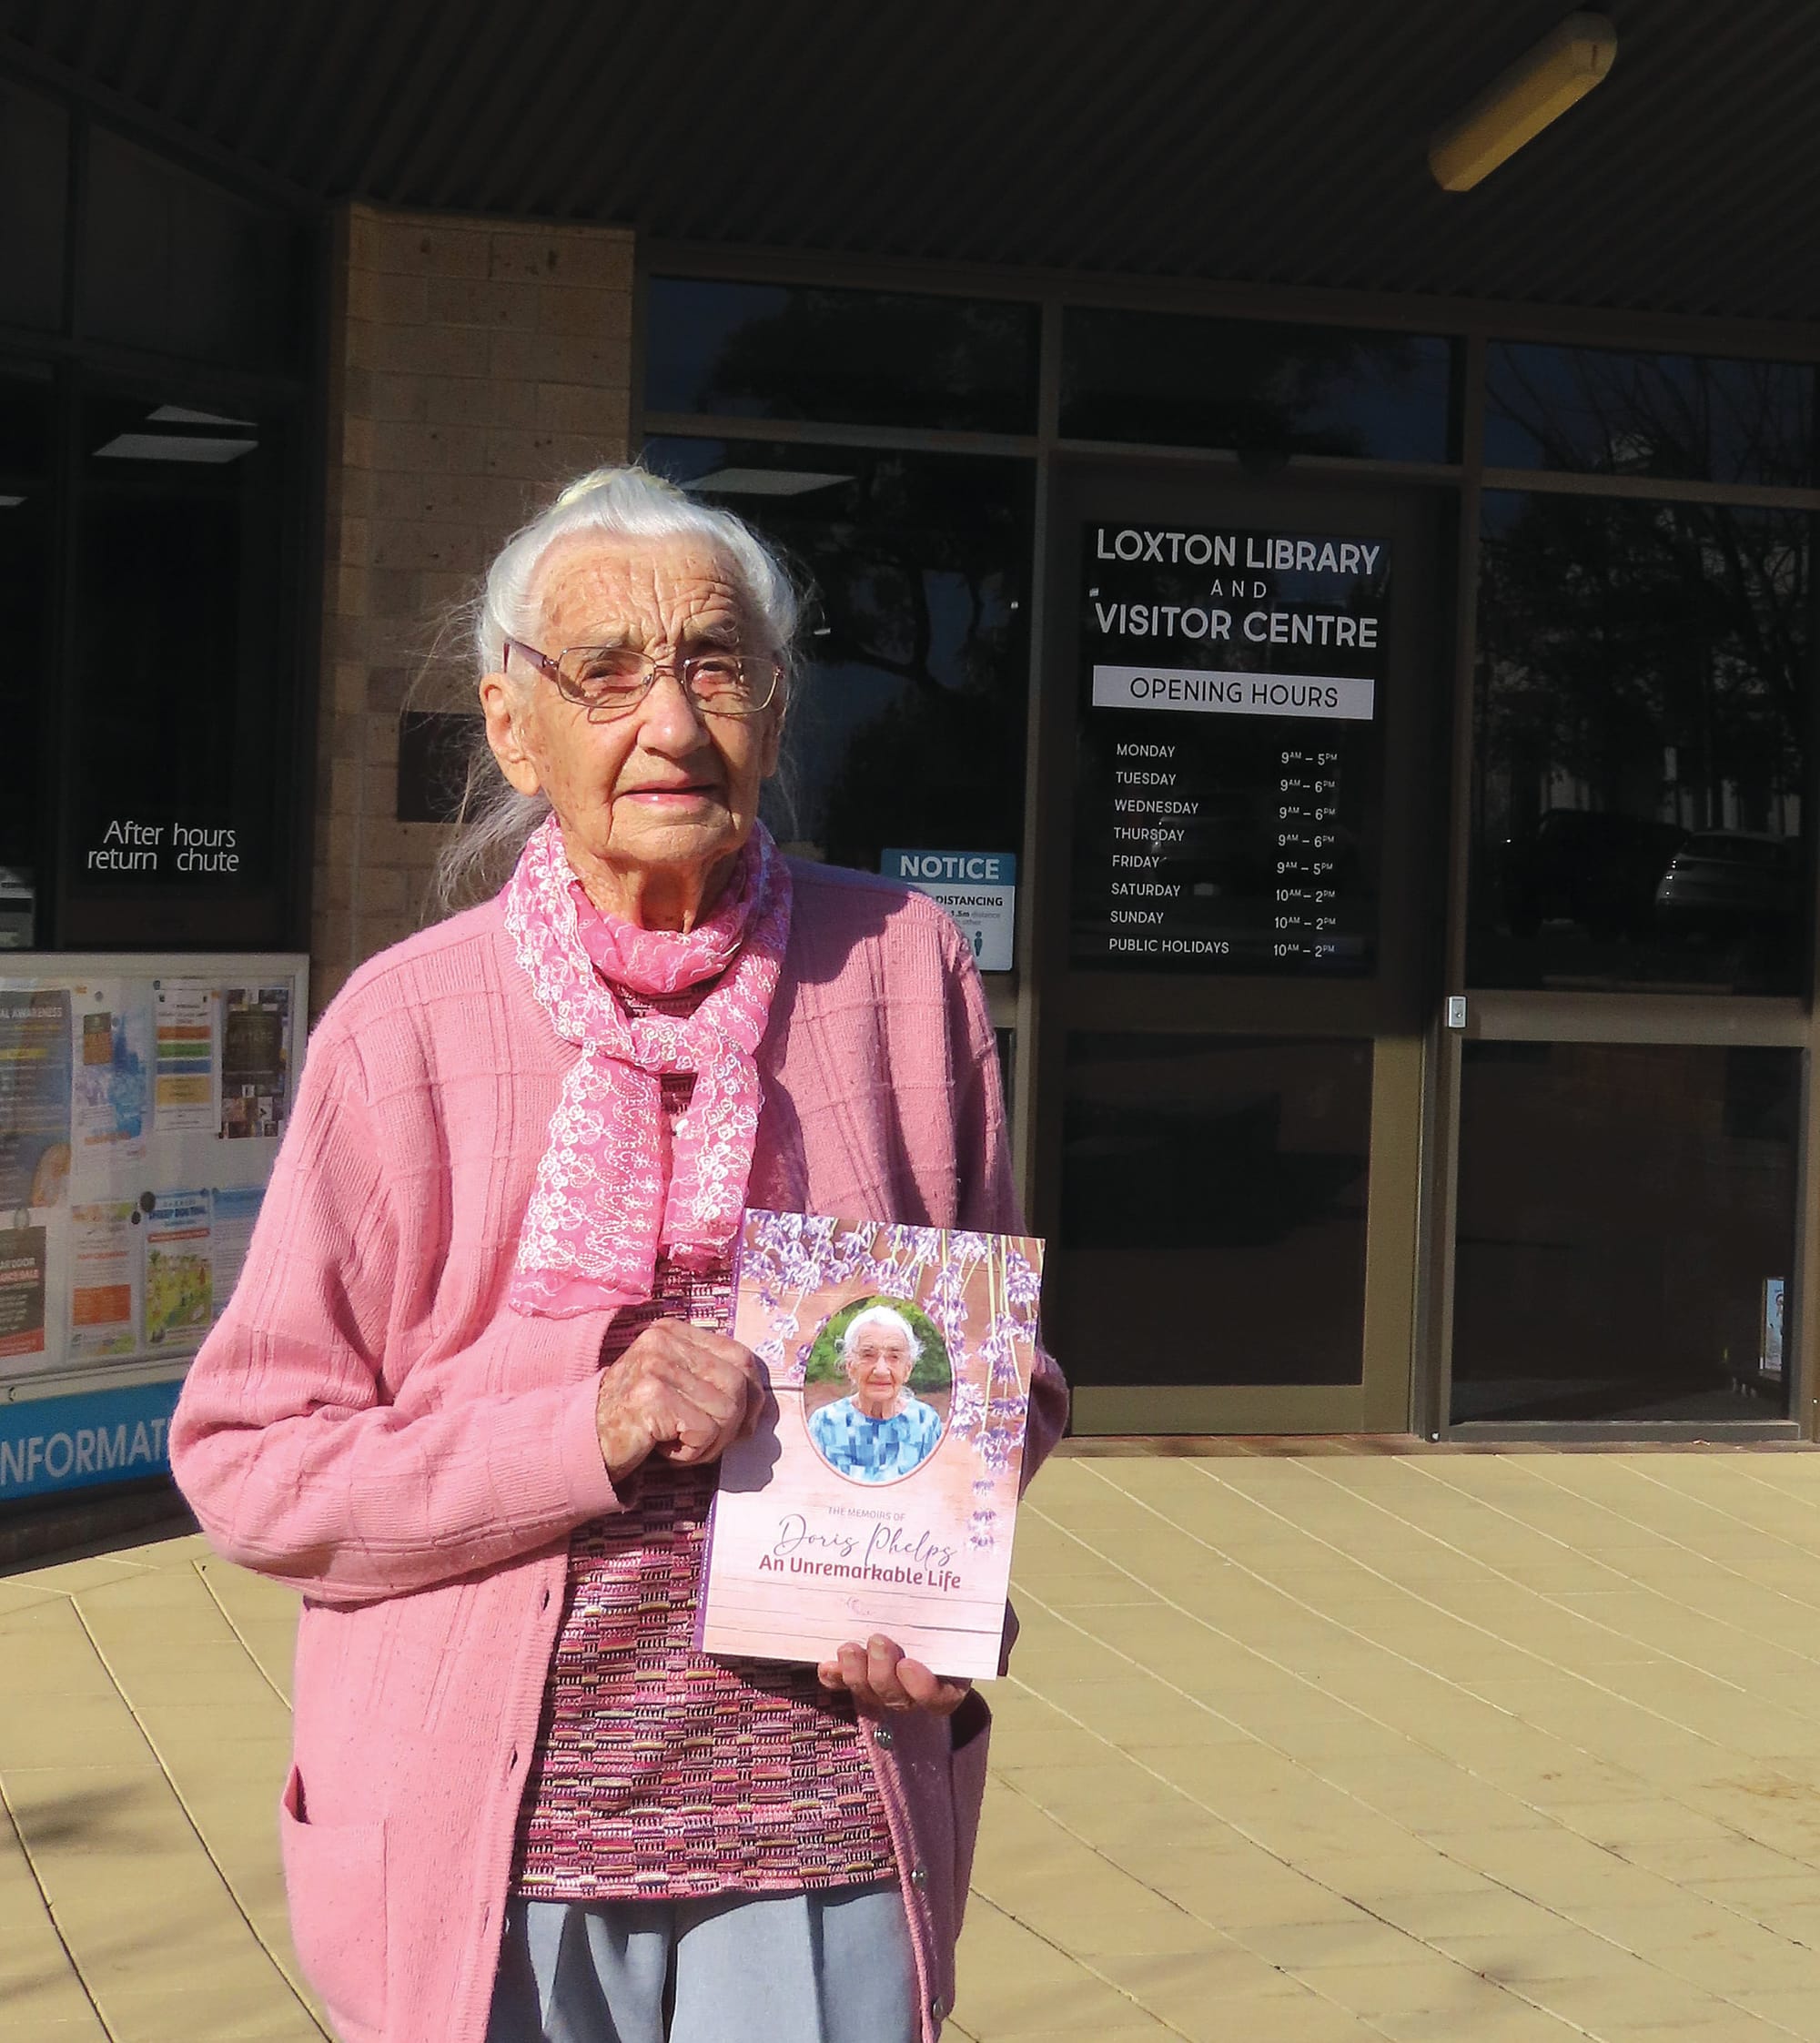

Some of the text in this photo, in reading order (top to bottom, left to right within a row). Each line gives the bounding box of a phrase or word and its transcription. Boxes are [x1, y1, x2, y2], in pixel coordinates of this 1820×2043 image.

[1097, 528, 1380, 575] LOXTON LIBRARY
[1210, 579, 1267, 599] AND
[1095, 602, 1378, 648] VISITOR CENTRE
[1129, 677, 1338, 708] OPENING HOURS
[1117, 743, 1176, 758] MONDAY
[1281, 751, 1302, 764] 9AM
[1317, 753, 1338, 766] 5PM
[1116, 771, 1177, 786] TUESDAY
[1280, 779, 1301, 792] 9AM
[1314, 780, 1335, 794] 6PM
[1114, 799, 1198, 814] WEDNESDAY
[1279, 805, 1300, 819] 9AM
[1315, 807, 1336, 821] 6PM
[103, 820, 236, 848] After hours
[1113, 827, 1185, 841] THURSDAY
[1278, 834, 1299, 846] 9AM
[1314, 834, 1335, 848] 6PM
[87, 847, 239, 872] return chute
[901, 855, 999, 879] NOTICE
[1112, 855, 1160, 868] FRIDAY
[1277, 861, 1298, 874] 9AM
[1313, 862, 1333, 875] 5PM
[936, 895, 1003, 906] DISTANCING
[1110, 882, 1181, 897] SATURDAY
[1276, 888, 1301, 902] 10AM
[1315, 889, 1336, 903] 2PM
[1110, 910, 1164, 925] SUNDAY
[1274, 916, 1300, 929] 10AM
[1316, 916, 1336, 930] 2PM
[1108, 937, 1158, 952] PUBLIC
[1161, 940, 1229, 954] HOLIDAYS
[1273, 944, 1299, 956] 10AM
[1314, 945, 1335, 958] 2PM
[827, 1506, 906, 1521] THE MEMOIRS OF
[774, 1513, 957, 1572] Doris Phelps
[759, 1554, 962, 1591] An Unremarkable Life
